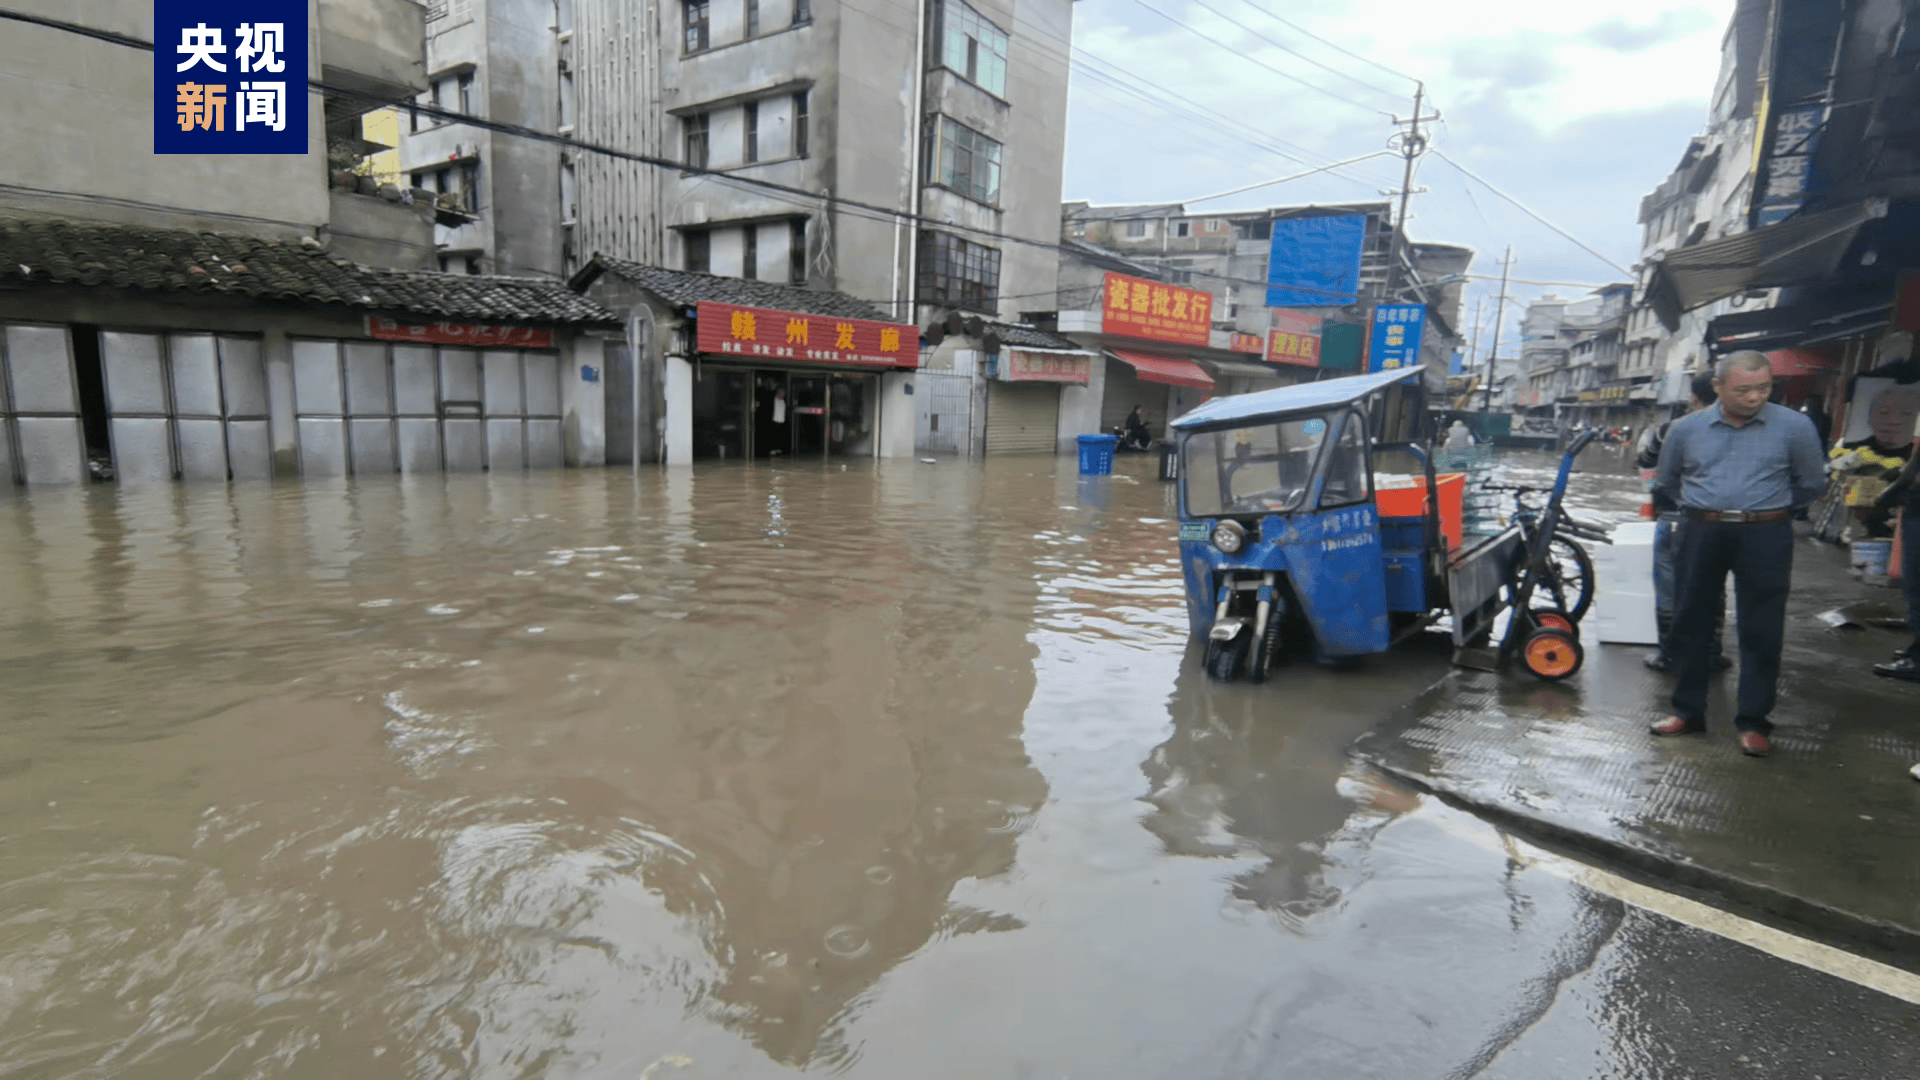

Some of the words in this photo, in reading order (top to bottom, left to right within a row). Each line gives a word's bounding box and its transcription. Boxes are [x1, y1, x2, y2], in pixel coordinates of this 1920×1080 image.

[1110, 279, 1208, 323] 瓷器批发行
[731, 311, 899, 352] 赣州发廊
